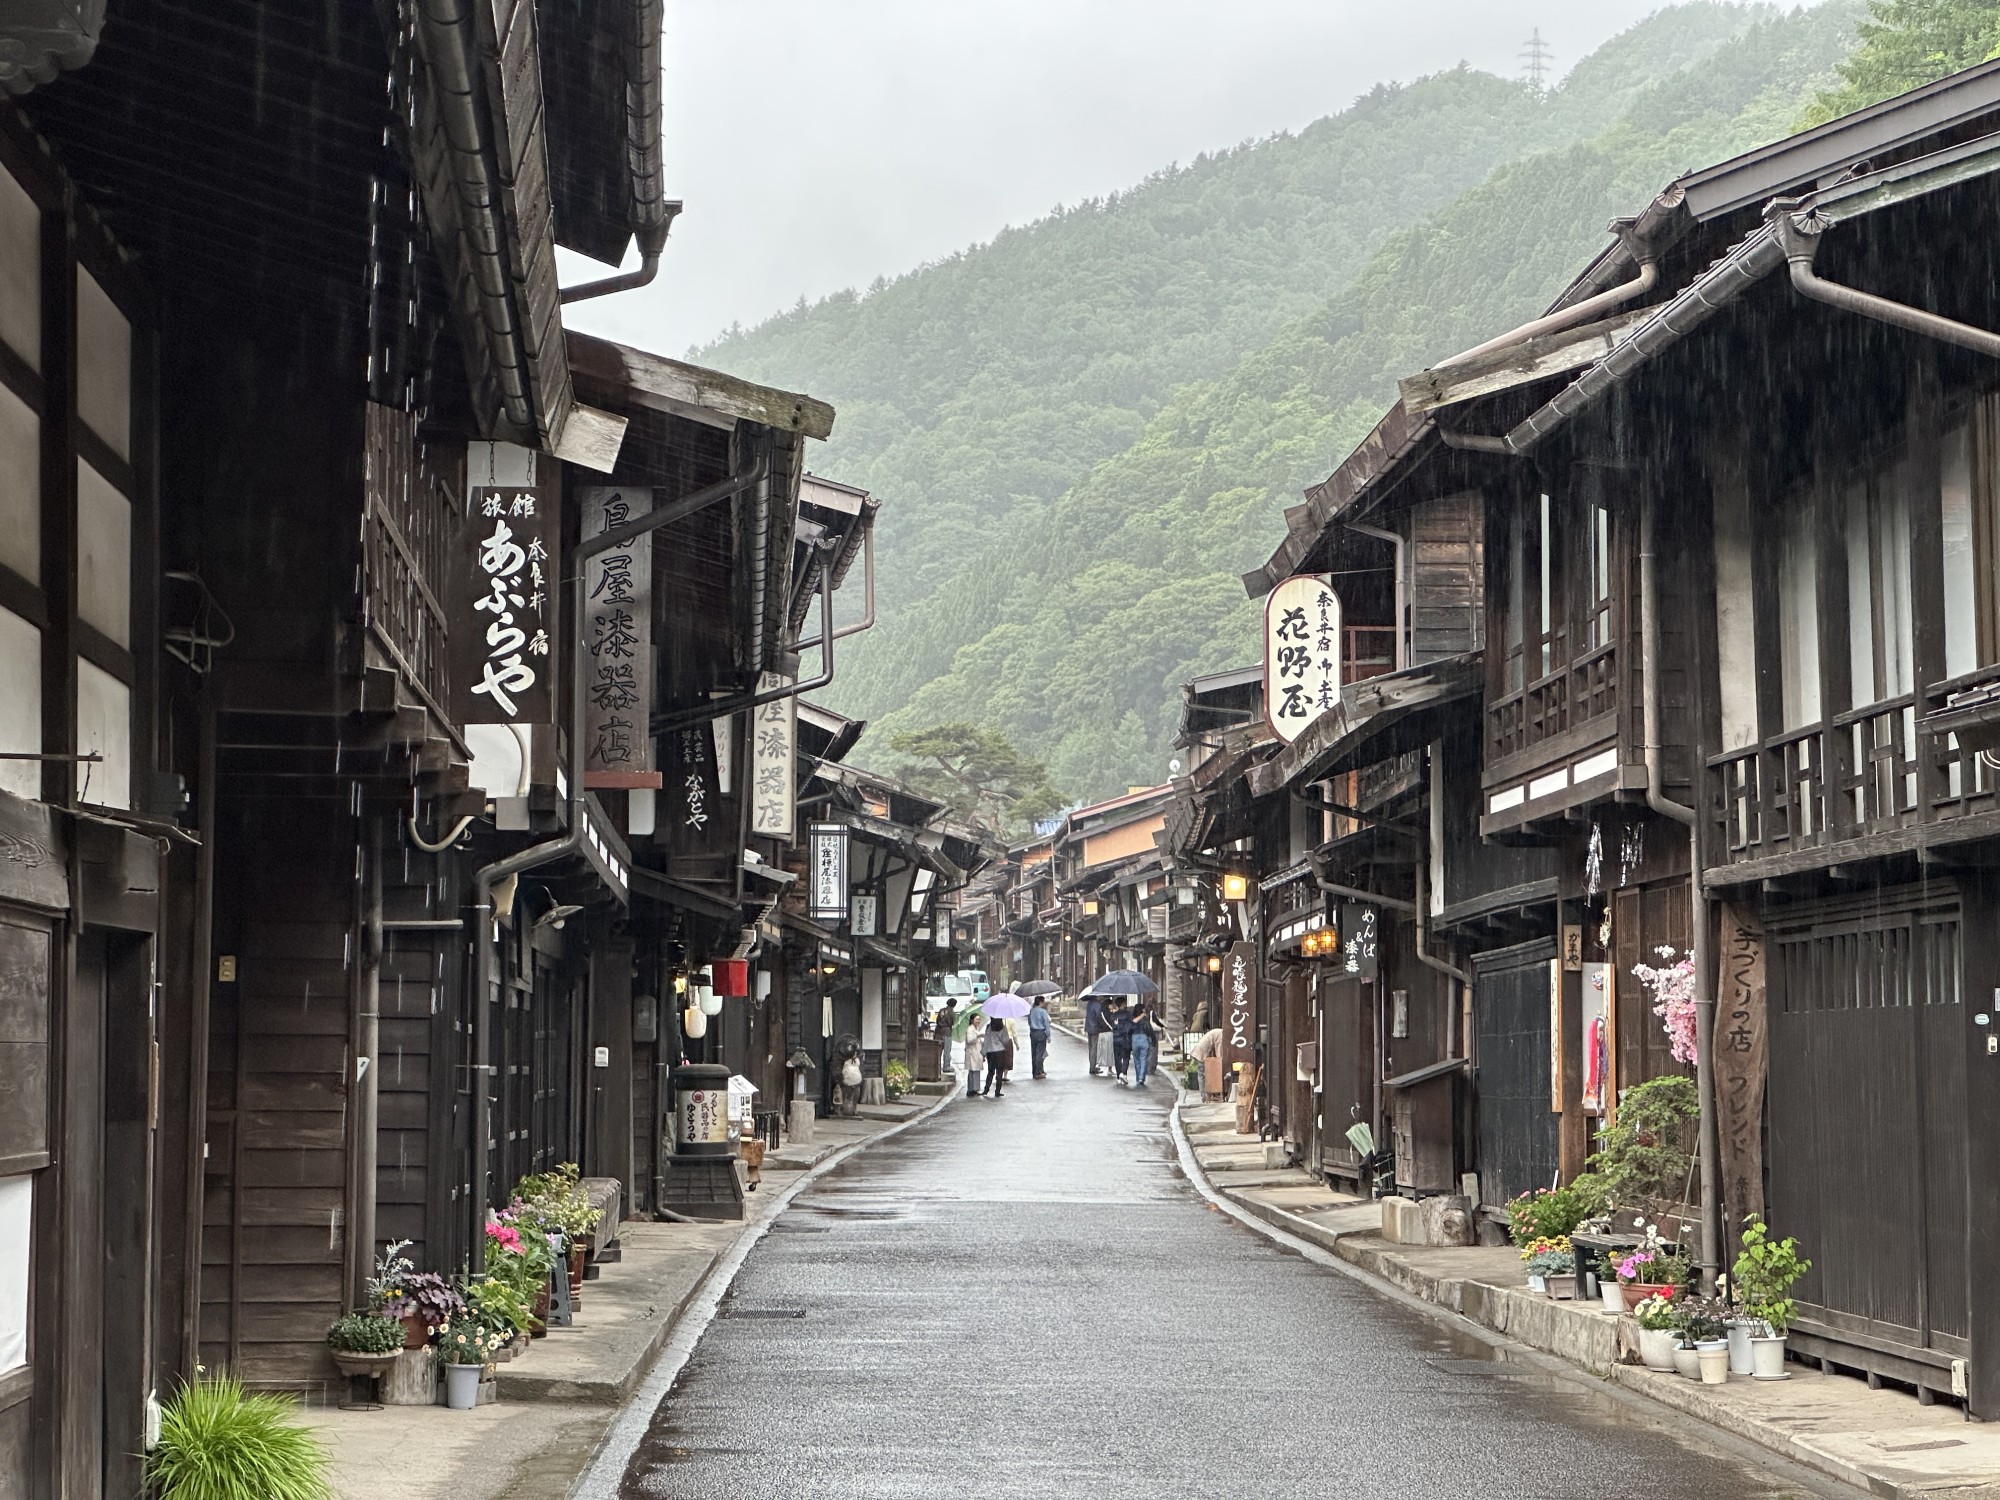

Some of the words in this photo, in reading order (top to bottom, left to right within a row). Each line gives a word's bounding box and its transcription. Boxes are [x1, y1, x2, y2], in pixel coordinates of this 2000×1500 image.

[482, 493, 536, 518] 旅館
[471, 520, 536, 717] あぶらや
[527, 536, 549, 656] 奈良井宿
[1316, 590, 1334, 652] 奈良井宿
[1276, 606, 1313, 718] 花野屋
[685, 774, 708, 831] ながとや
[1345, 939, 1360, 972] 漆の器
[1356, 931, 1363, 942] &
[1726, 926, 1759, 1052] 手づくりの店
[1728, 1077, 1748, 1160] フレンド
